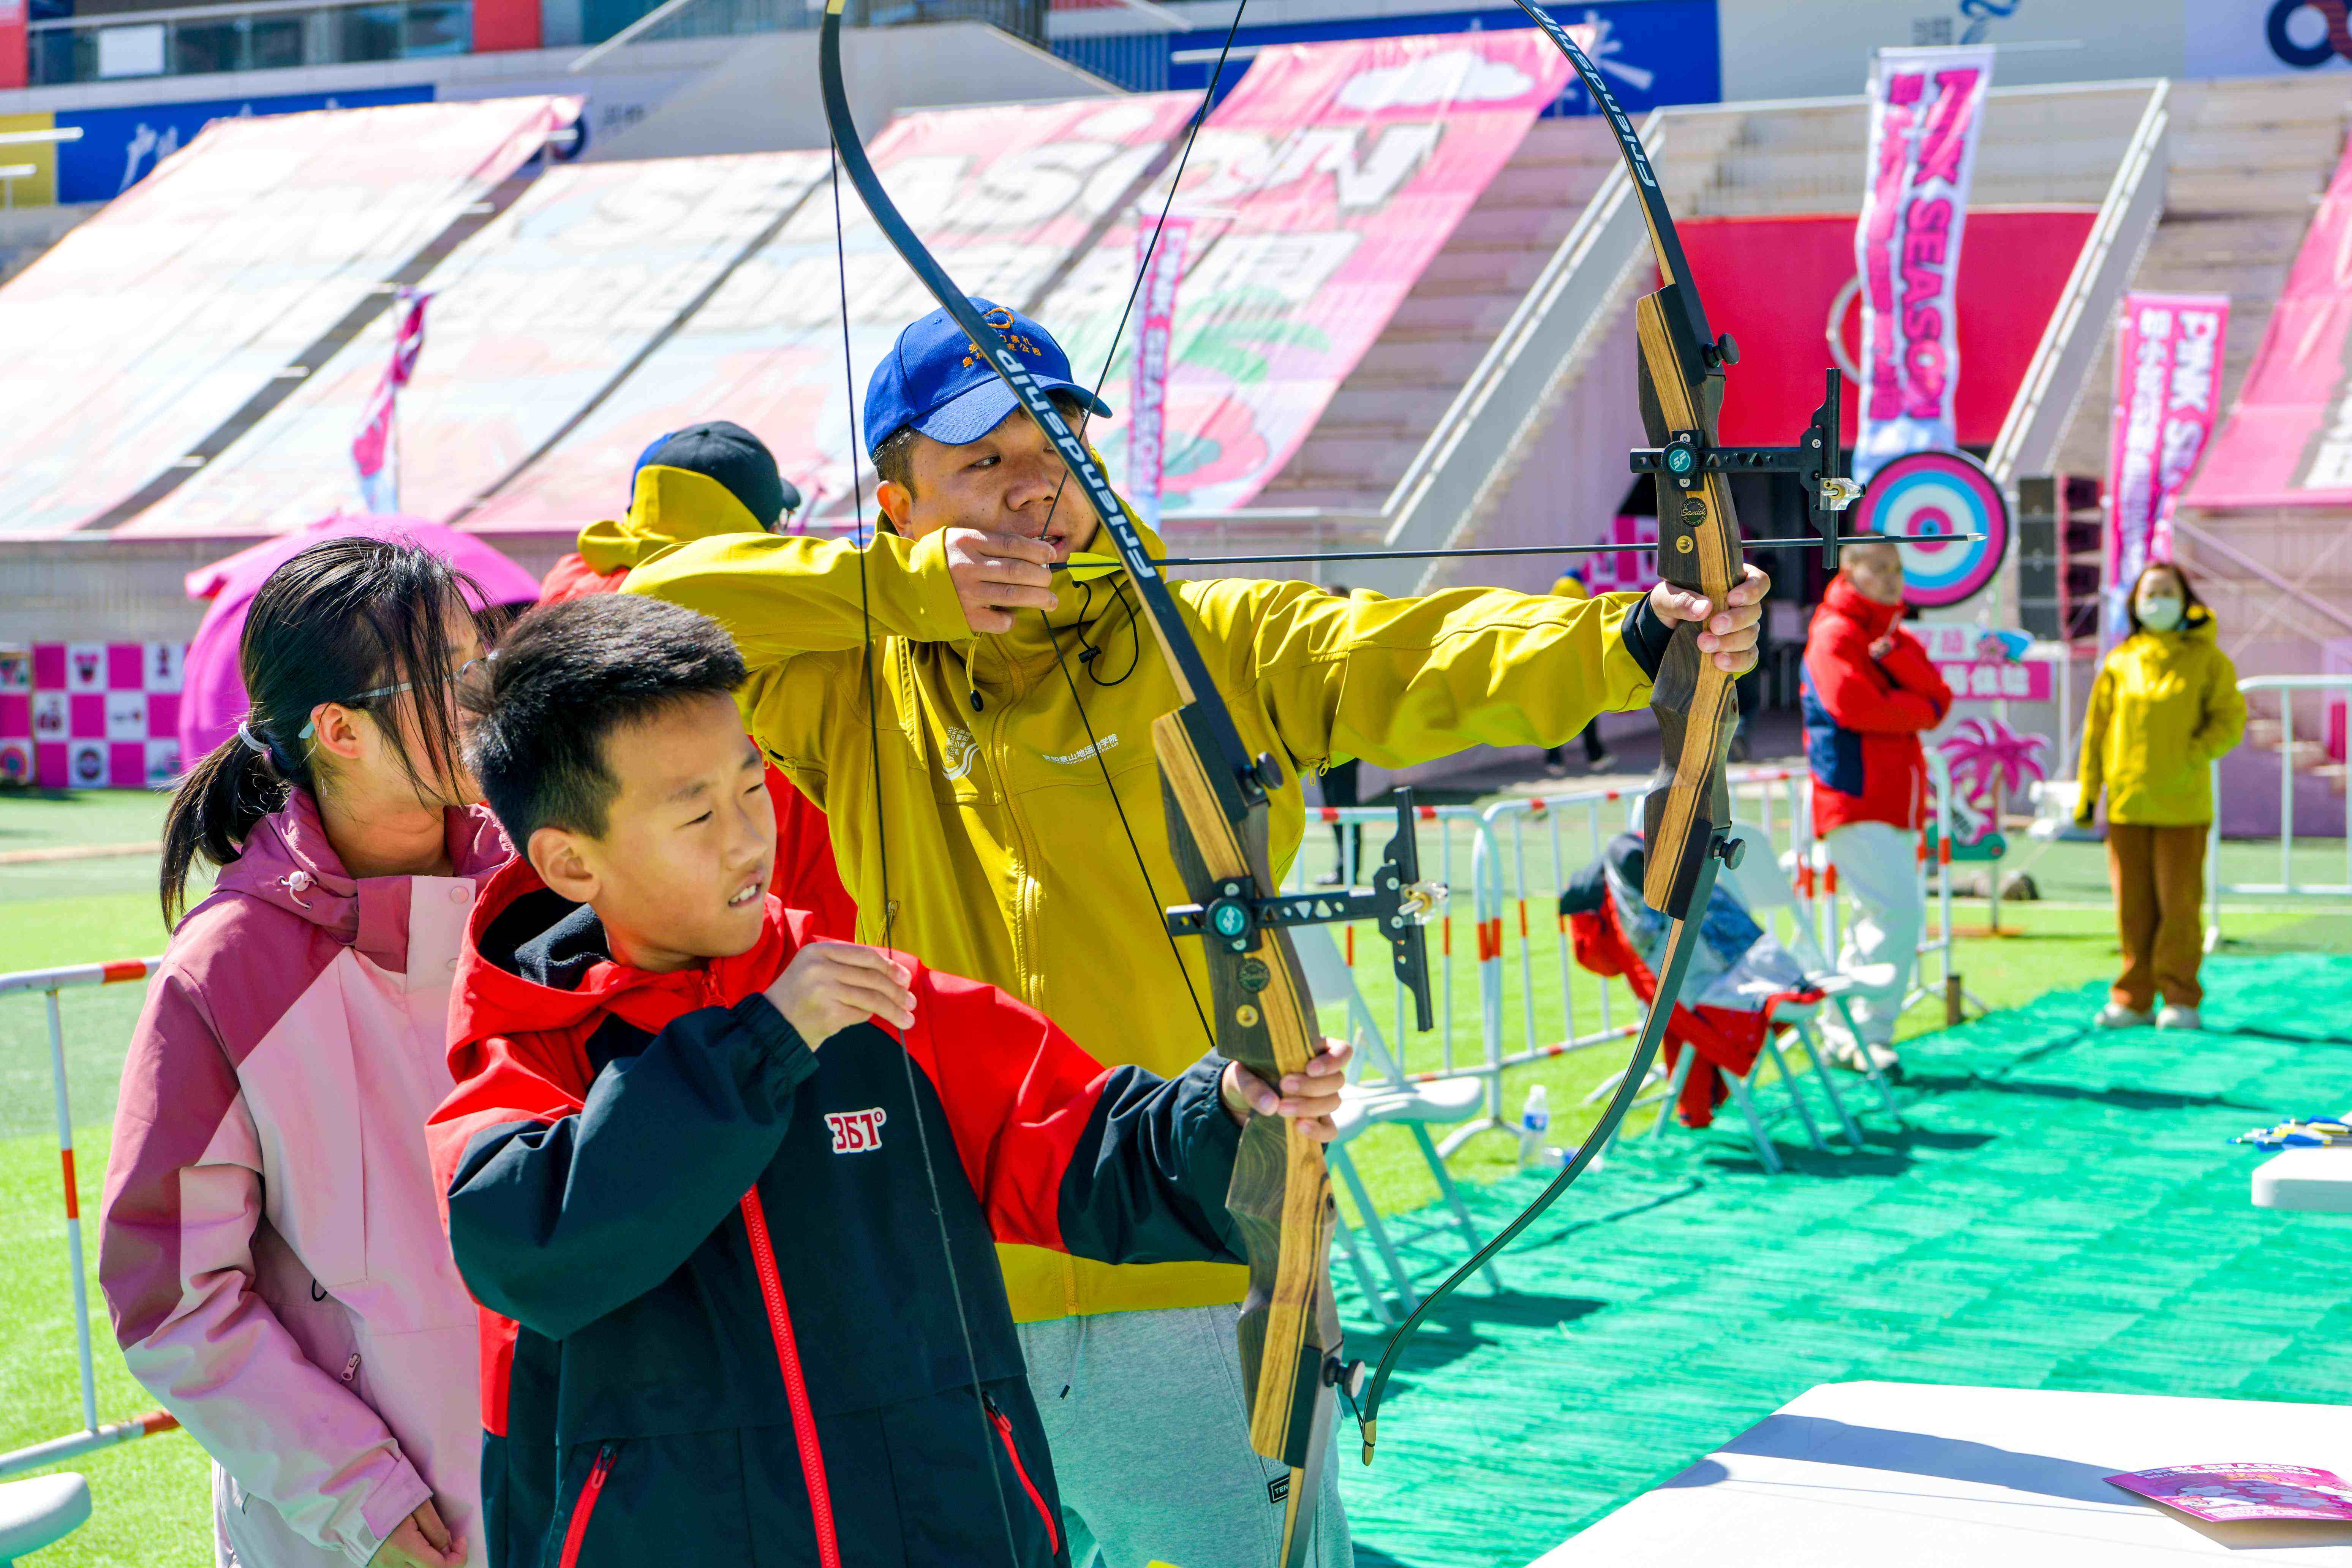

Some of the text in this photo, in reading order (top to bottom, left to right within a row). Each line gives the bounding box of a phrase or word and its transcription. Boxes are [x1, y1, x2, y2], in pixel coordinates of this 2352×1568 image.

[1533, 6, 1657, 187] Friendship
[2168, 311, 2218, 412] PINK
[996, 349, 1157, 579] Friendship
[1681, 507, 1706, 517] Samick
[950, 727, 959, 746] SNOW
[828, 1110, 884, 1151] 361°
